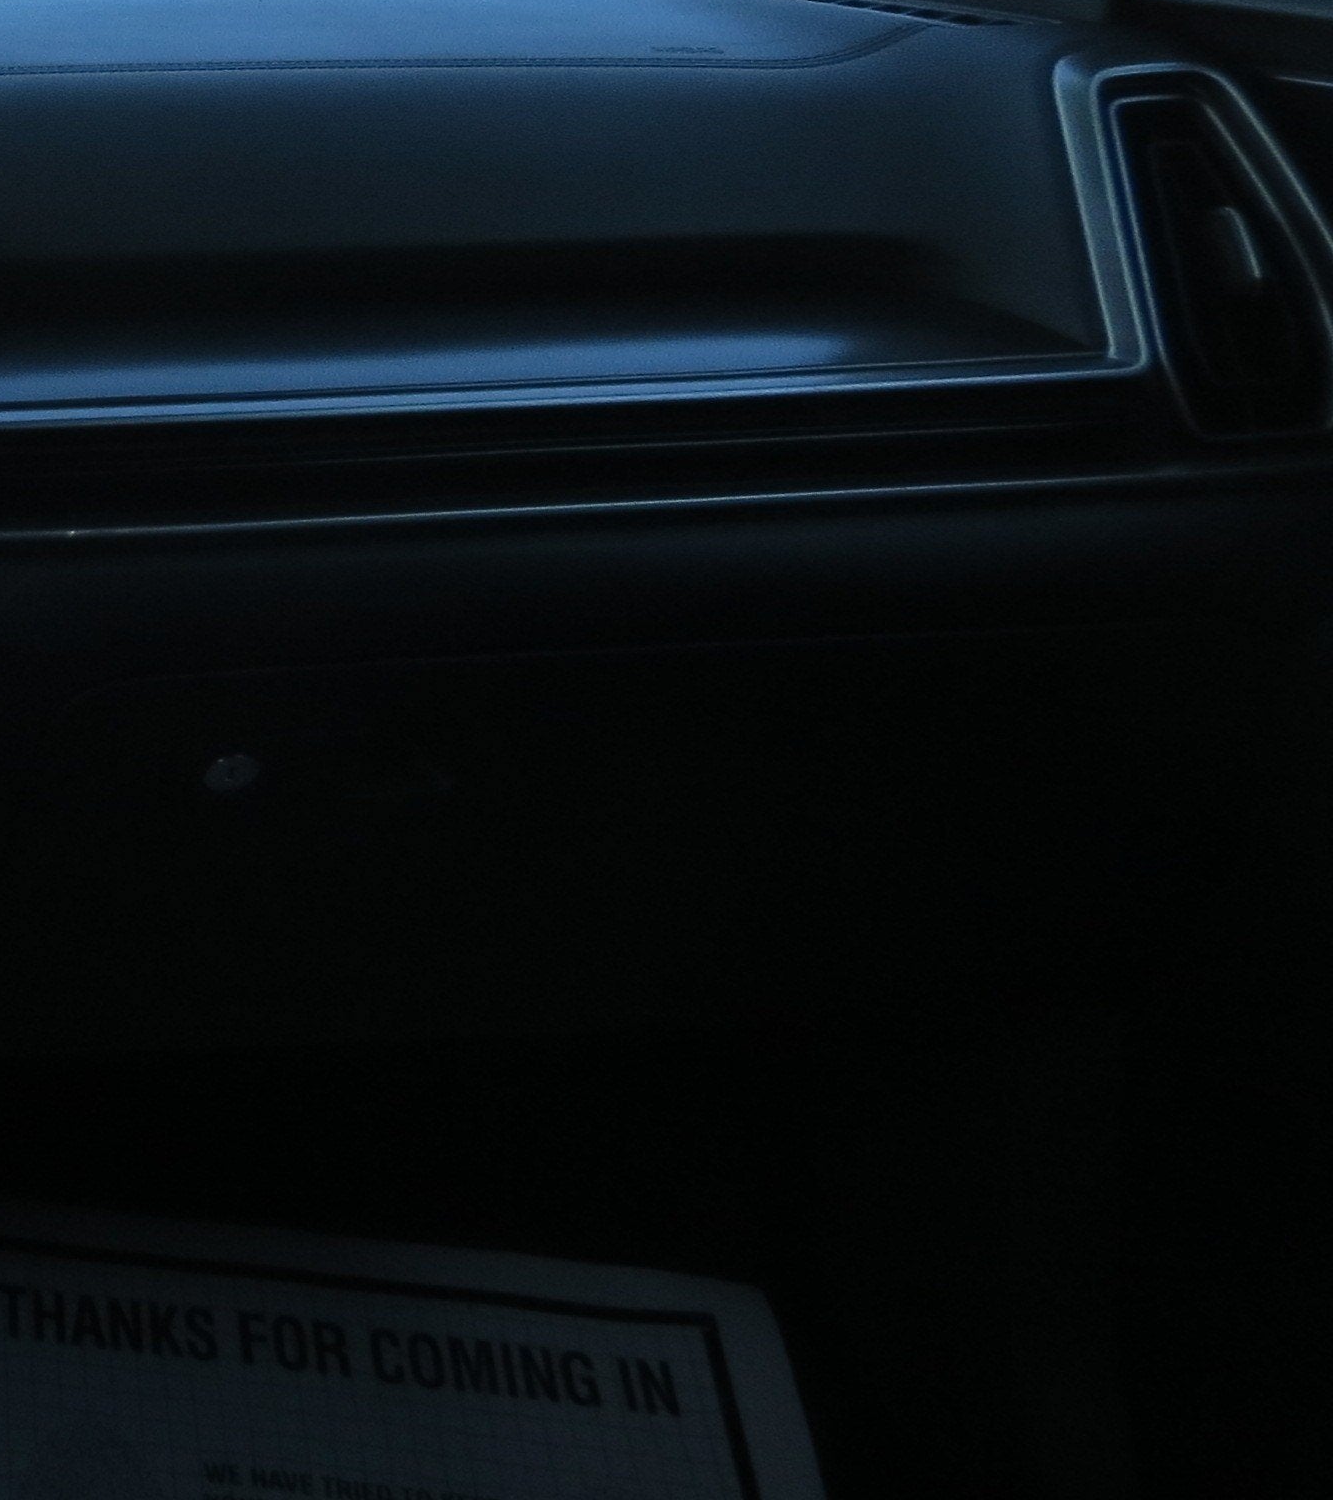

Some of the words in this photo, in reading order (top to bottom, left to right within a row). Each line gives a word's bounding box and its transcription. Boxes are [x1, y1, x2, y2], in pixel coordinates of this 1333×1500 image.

[237, 1308, 351, 1378] FOR
[372, 1327, 603, 1408] COMING
[617, 1355, 681, 1418] IN
[203, 1462, 243, 1486] WE
[251, 1467, 314, 1496] HAVE
[321, 1475, 394, 1500] TRIED
